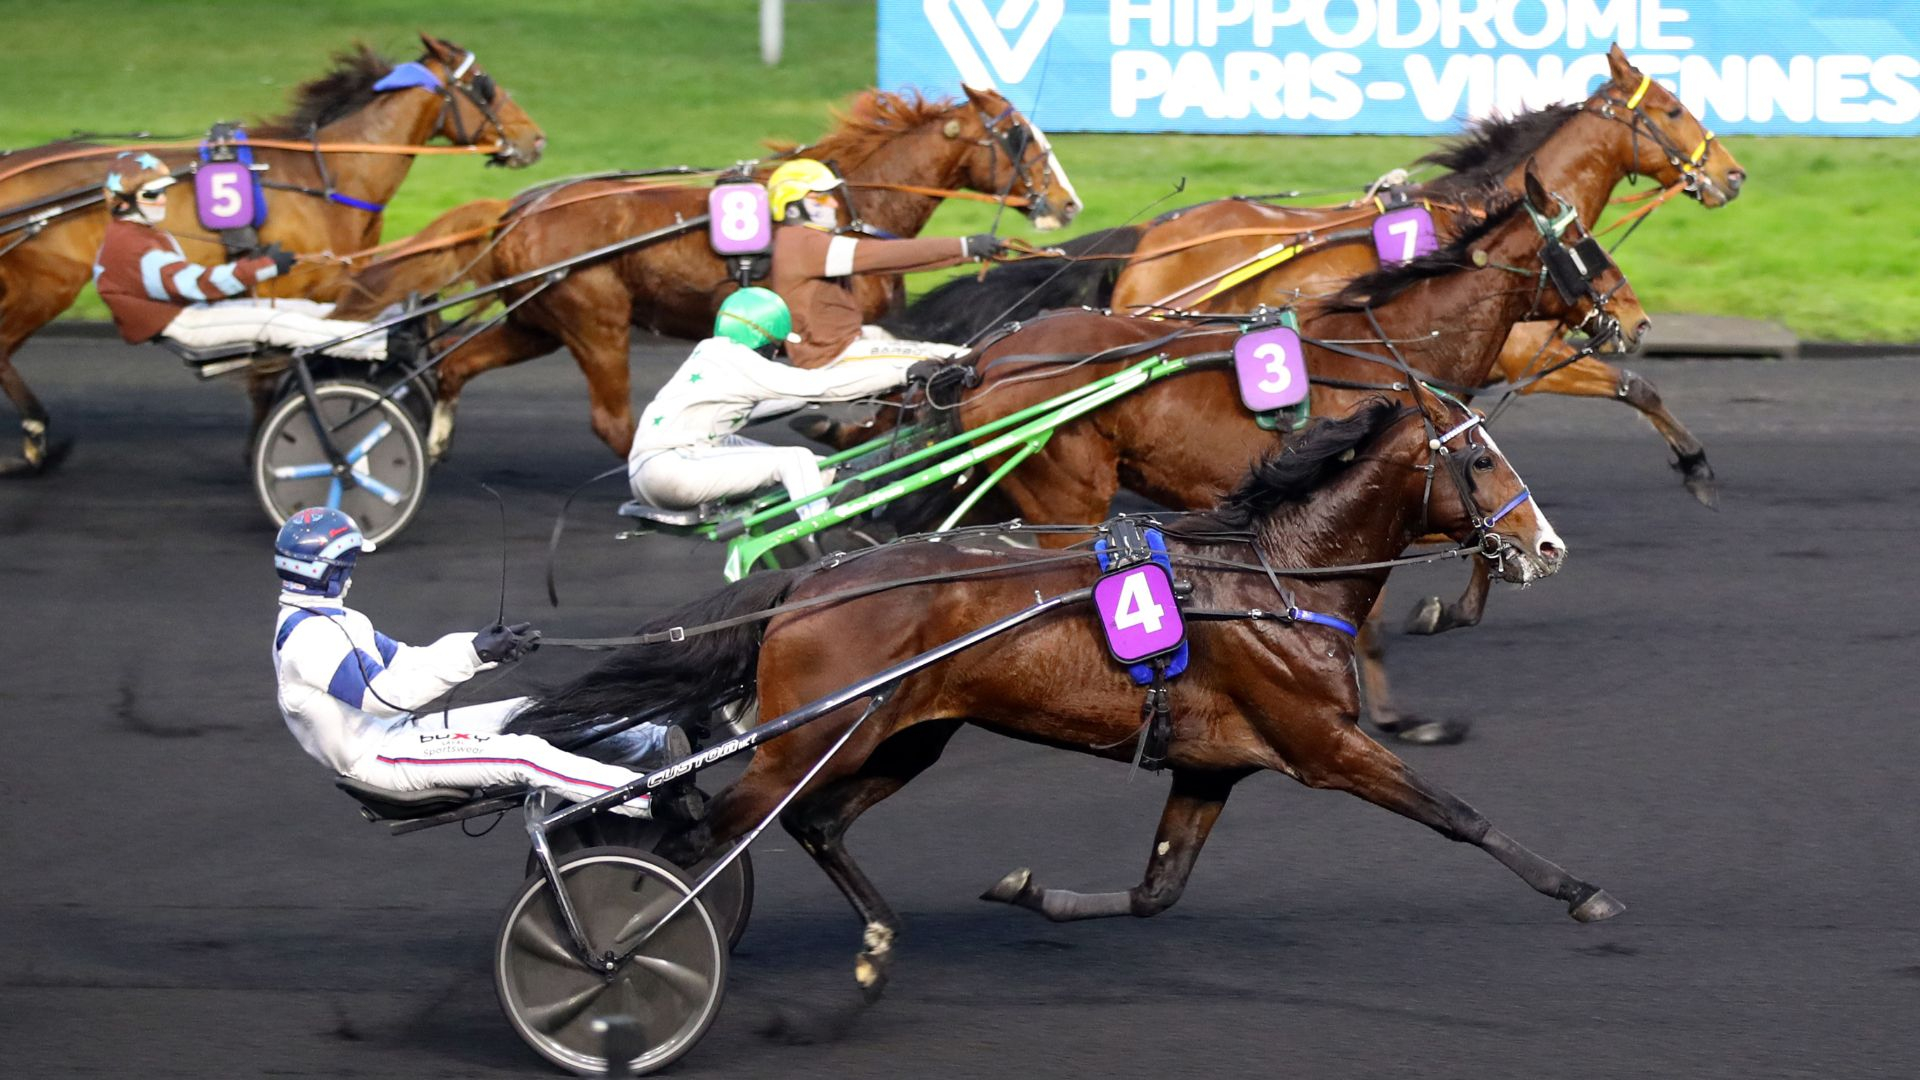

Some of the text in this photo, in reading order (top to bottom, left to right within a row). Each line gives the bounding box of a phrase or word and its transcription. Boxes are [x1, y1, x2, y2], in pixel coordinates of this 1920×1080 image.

[1110, 0, 1694, 49] HIPPODROME
[210, 172, 242, 217] 5
[720, 190, 767, 241] 8
[1388, 219, 1418, 264] 7
[1253, 342, 1292, 394] 3
[1114, 571, 1165, 634] 4
[423, 745, 484, 756] sportswear
[647, 739, 739, 788] CUSTOM
